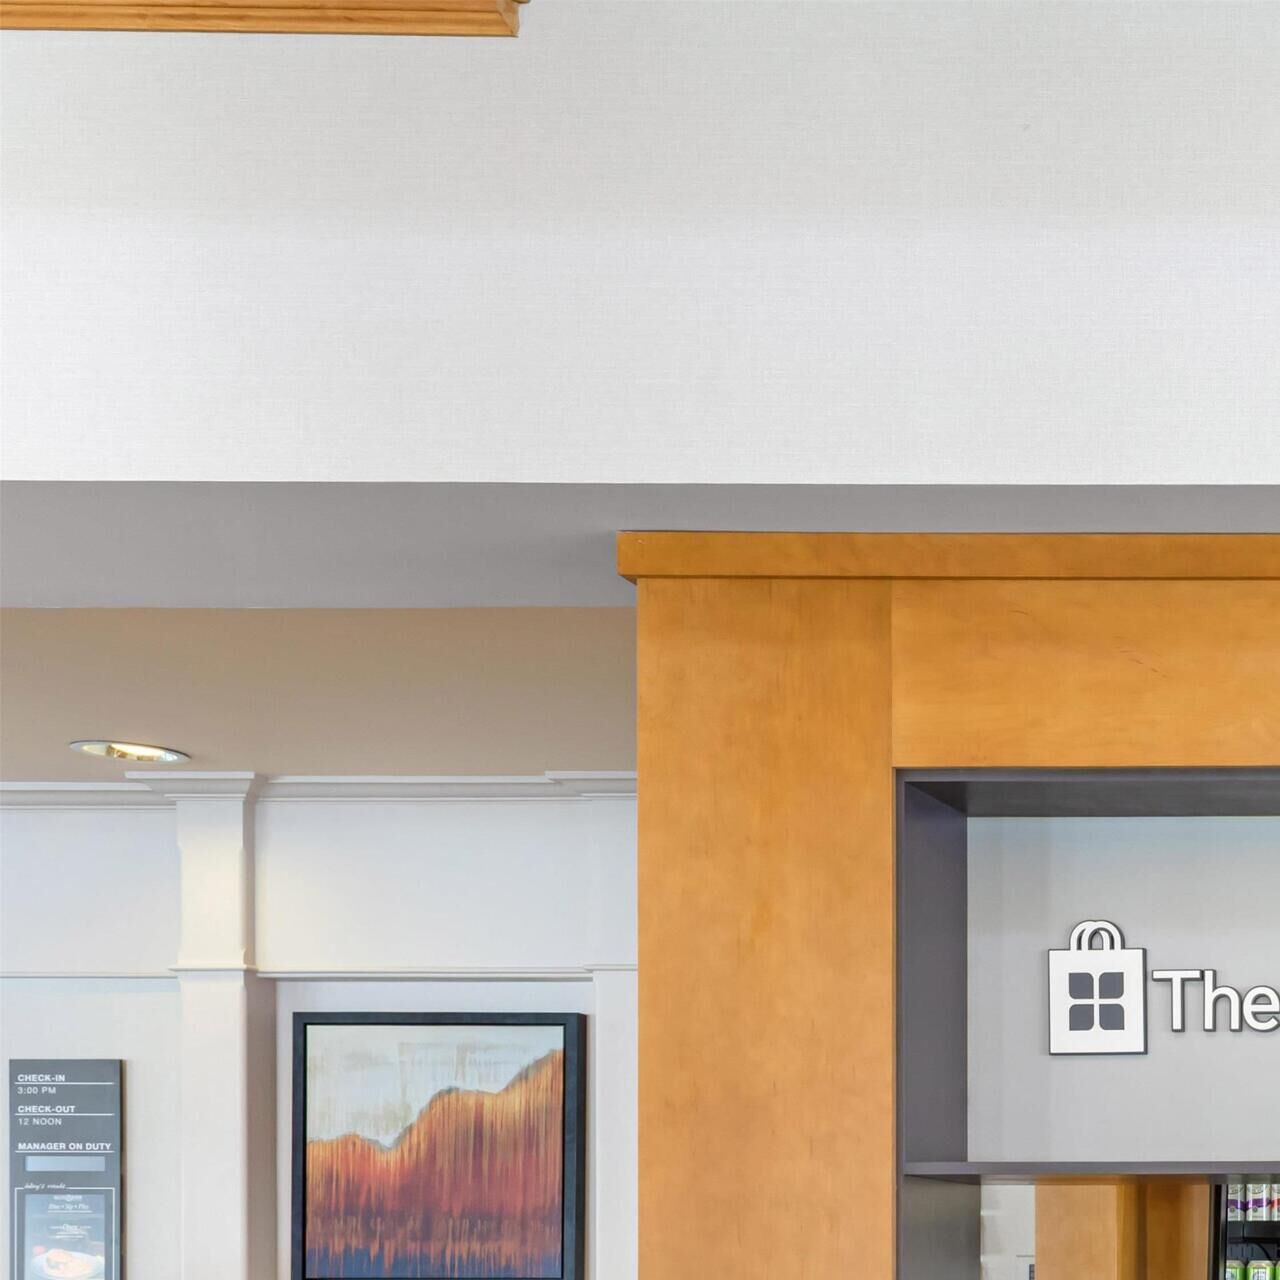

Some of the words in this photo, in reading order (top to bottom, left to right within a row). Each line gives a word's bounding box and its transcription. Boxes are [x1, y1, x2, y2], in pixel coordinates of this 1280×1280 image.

[17, 1074, 65, 1082] CHECK-IN
[17, 1105, 75, 1113] CHECK-OUT
[18, 1118, 29, 1126] 12
[33, 1118, 62, 1126] NOON
[18, 1142, 66, 1150] MANAGER
[68, 1142, 83, 1150] ON
[85, 1142, 111, 1150] DUTY
